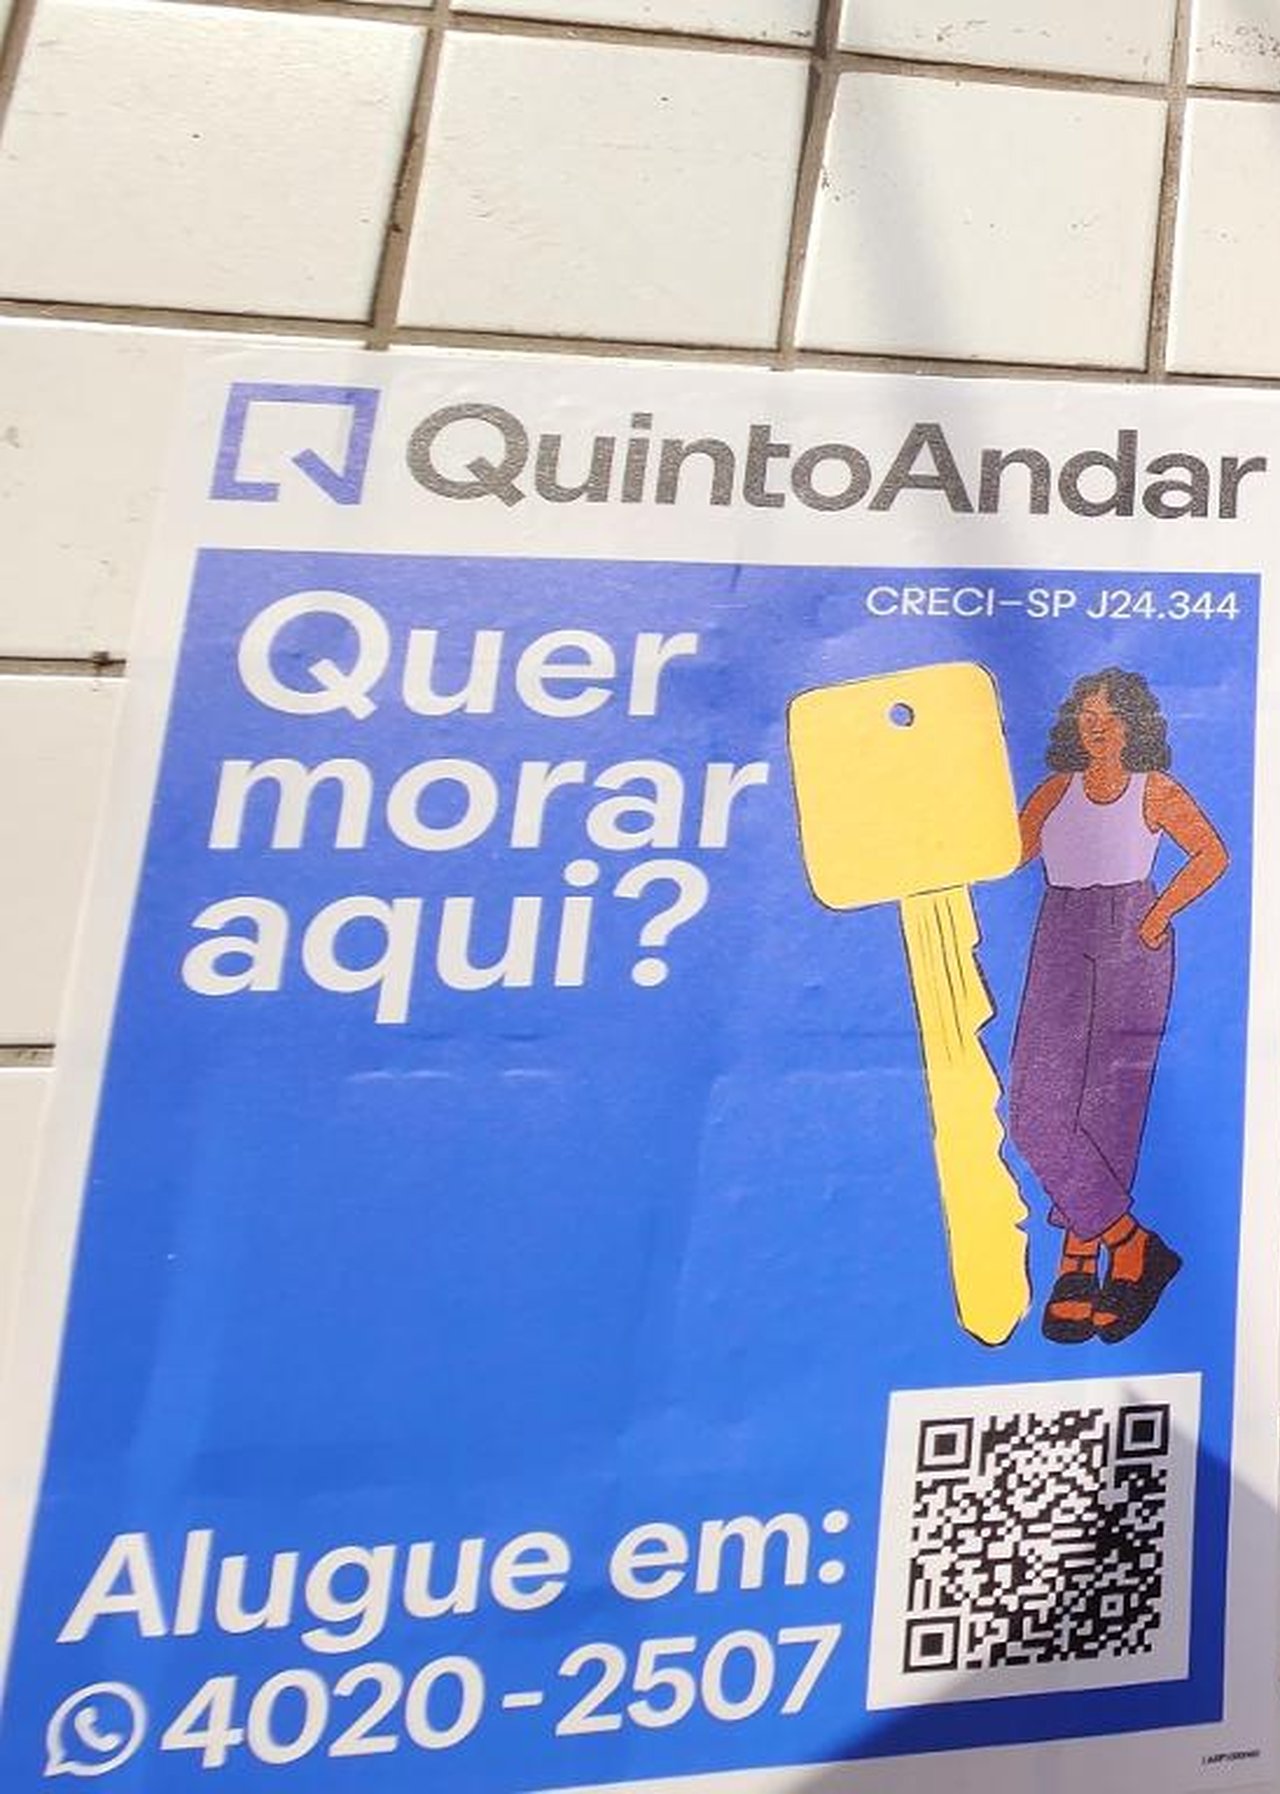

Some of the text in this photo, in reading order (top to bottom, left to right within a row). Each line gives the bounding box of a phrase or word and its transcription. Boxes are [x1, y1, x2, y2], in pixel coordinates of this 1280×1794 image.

[405, 402, 1267, 520] QuintoAndar
[237, 589, 698, 719] Quer
[1087, 590, 1240, 621] J24.344
[207, 755, 769, 852] morar
[180, 858, 709, 1025] aqui?
[56, 1507, 849, 1652] Alugue em:
[159, 1624, 843, 1769] 4020-2507
